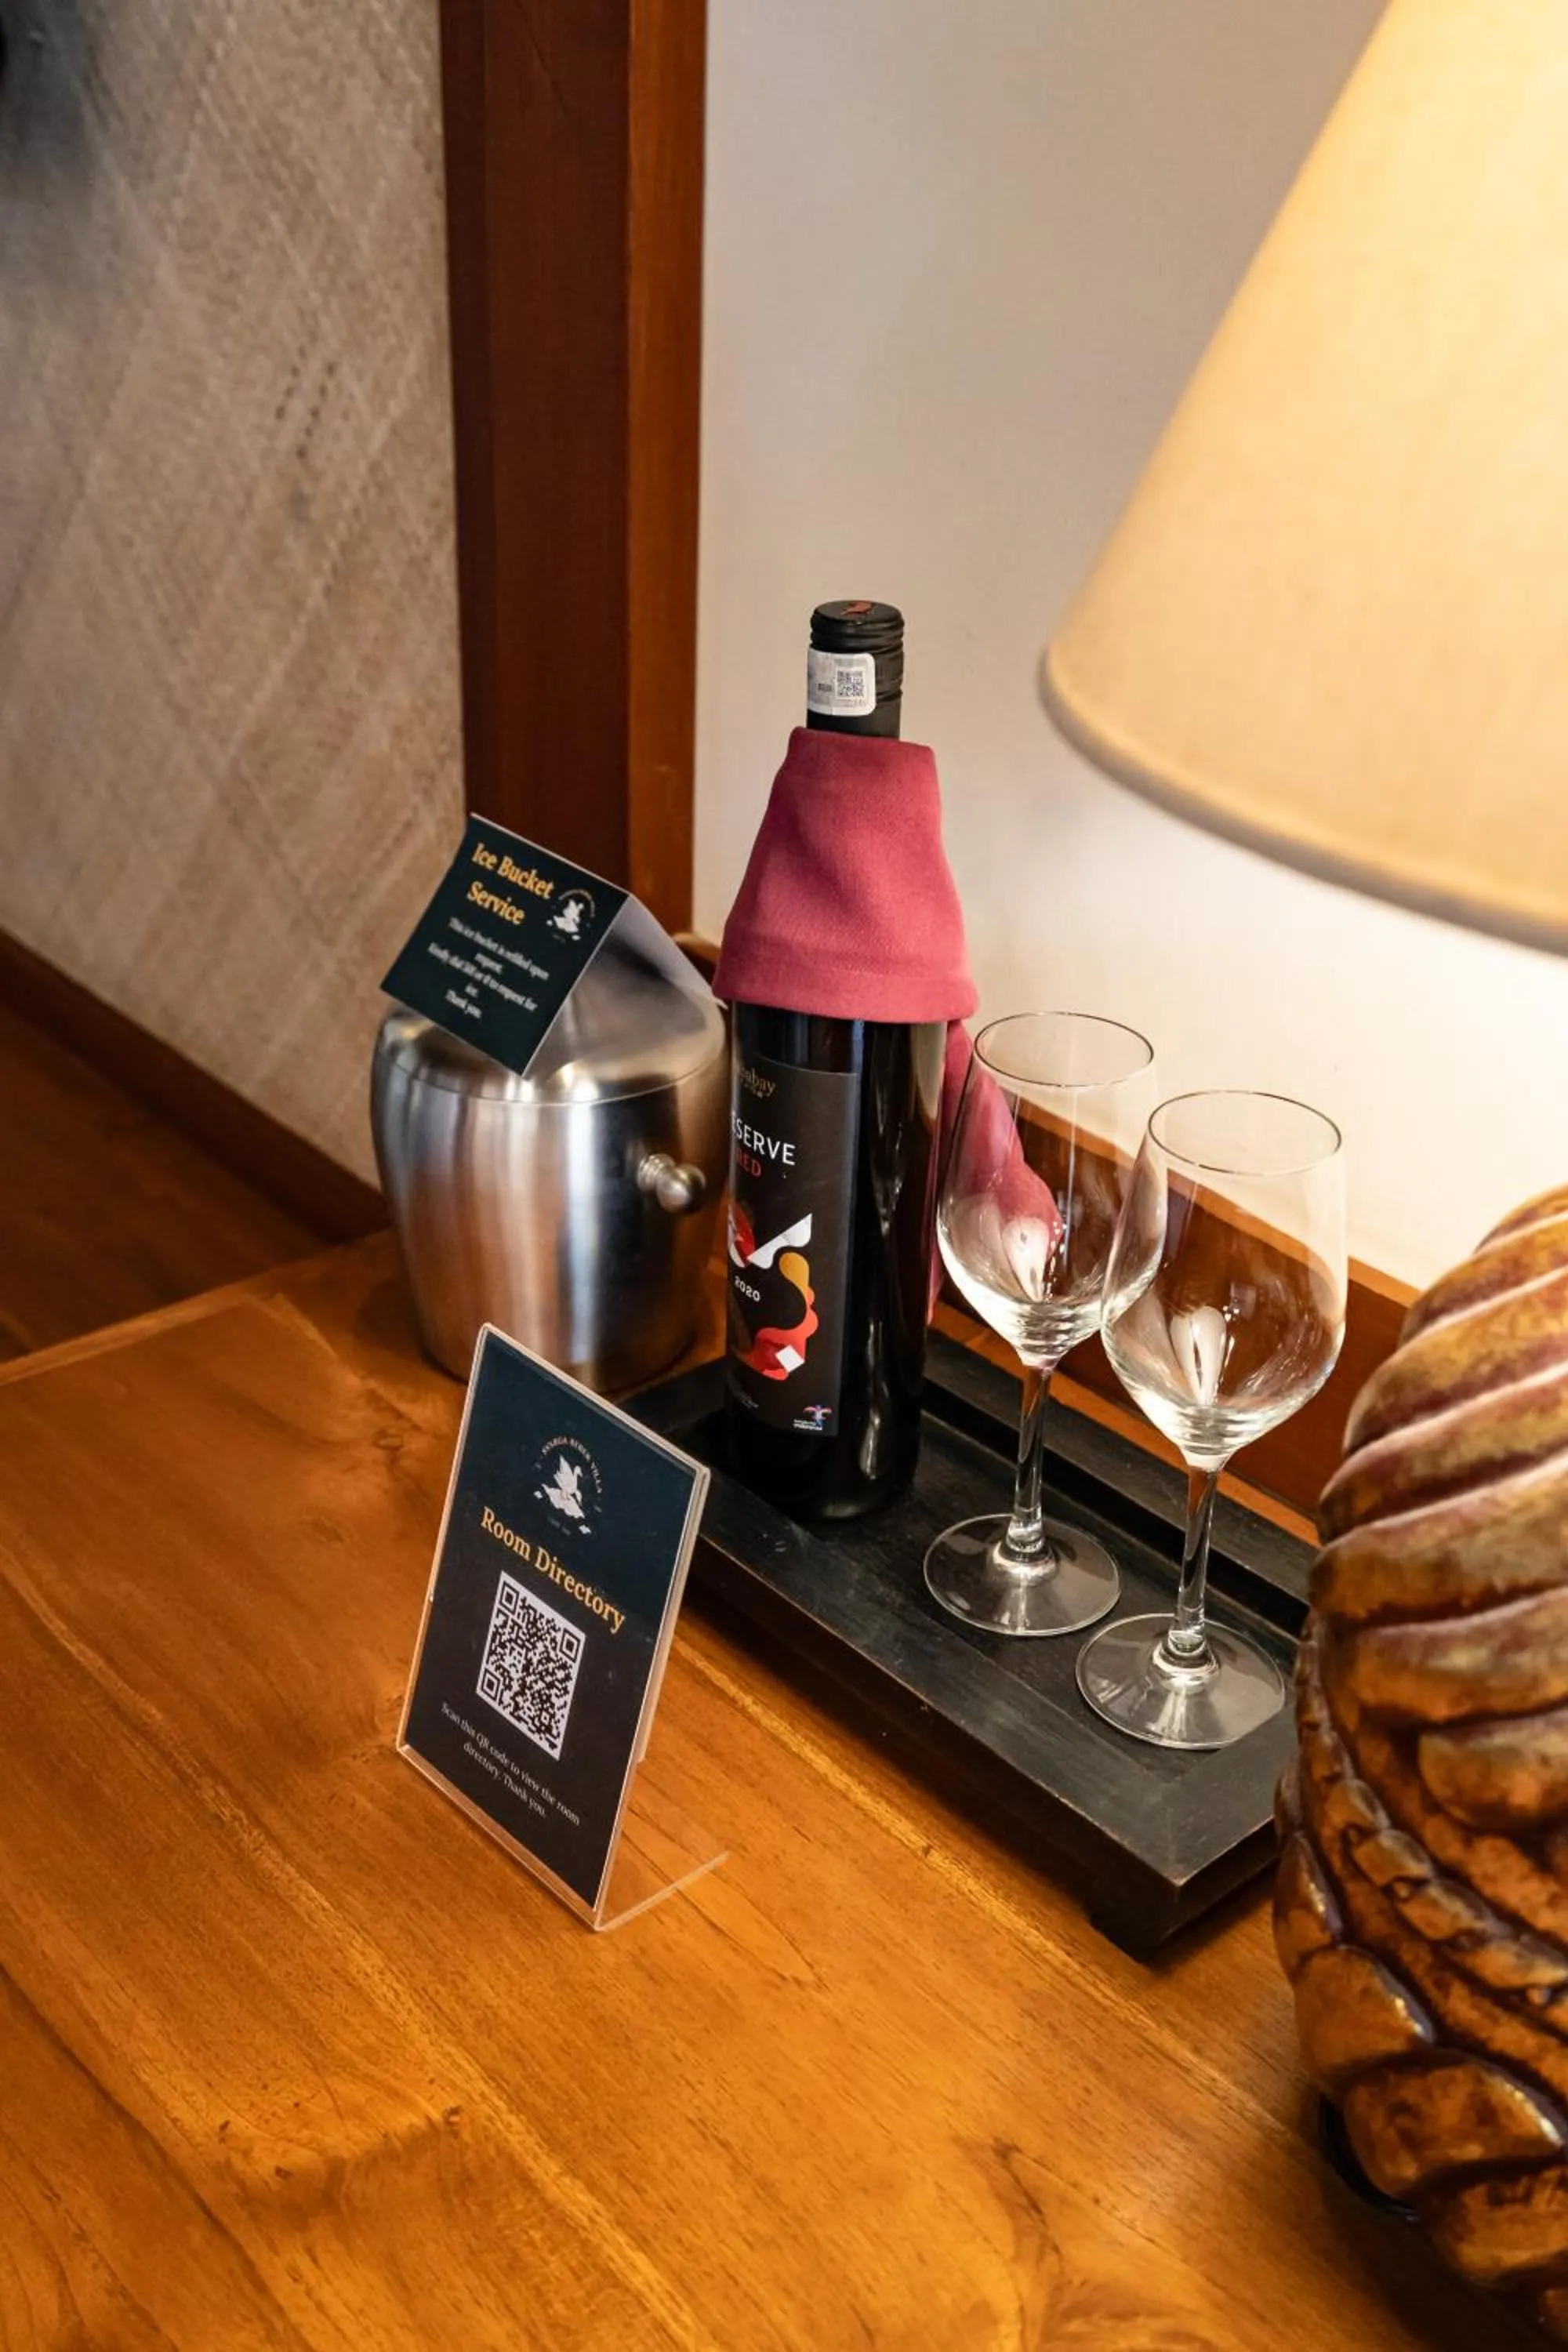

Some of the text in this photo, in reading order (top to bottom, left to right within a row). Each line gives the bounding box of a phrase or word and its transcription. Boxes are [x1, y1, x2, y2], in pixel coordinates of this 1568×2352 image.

[471, 842, 554, 900] Ice Bucket
[466, 880, 525, 925] Service
[735, 1275, 760, 1302] 2020
[481, 1505, 626, 1635] Room Directory
[441, 1701, 580, 1827] Scan this QR code to view the room
[463, 1741, 502, 1780] directory.
[503, 1772, 528, 1803] Thank
